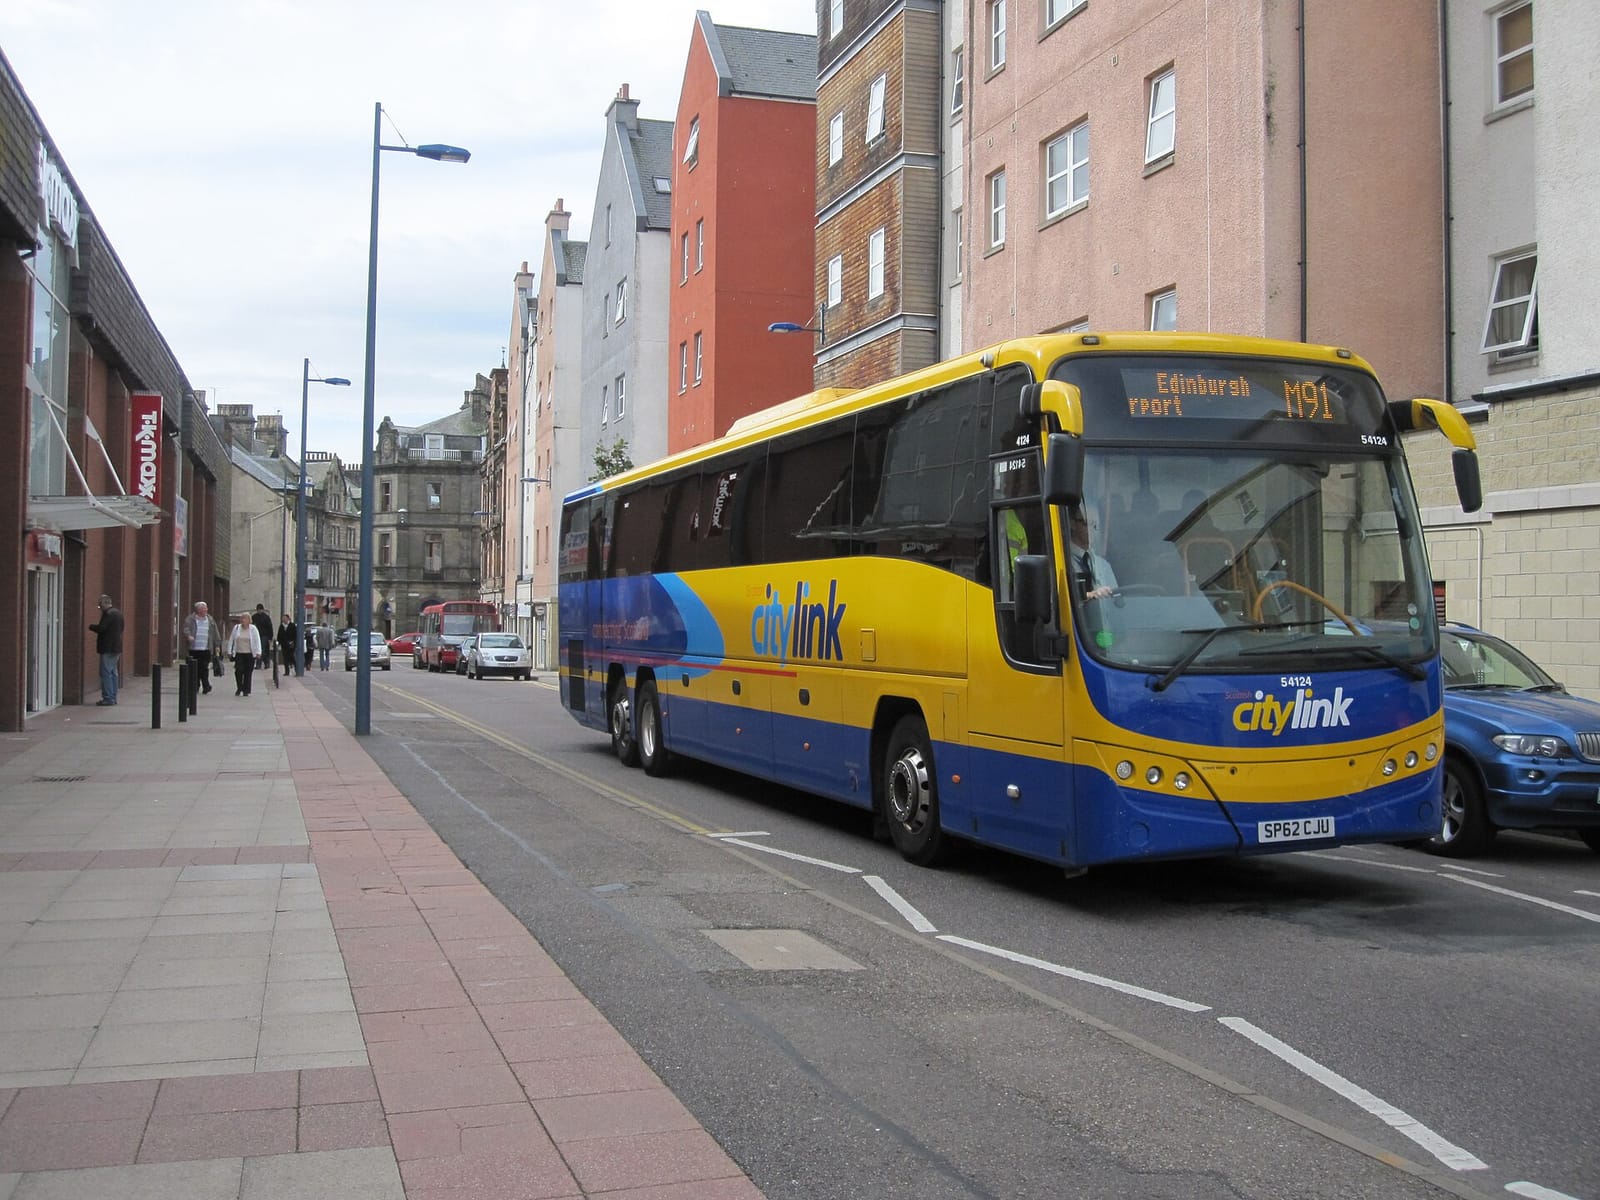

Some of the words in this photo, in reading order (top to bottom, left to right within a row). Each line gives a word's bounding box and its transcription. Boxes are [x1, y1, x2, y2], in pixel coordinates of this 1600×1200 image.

[1156, 372, 1250, 397] Edinburgh
[1129, 397, 1183, 416] rport
[1283, 380, 1334, 420] M91
[1016, 434, 1030, 447] 4124
[1361, 434, 1387, 446] 54124
[751, 579, 847, 668] citylink
[1281, 676, 1312, 687] 54124
[1232, 687, 1354, 736] citylink
[1264, 822, 1300, 838] SP62
[1303, 819, 1330, 835] CJU
